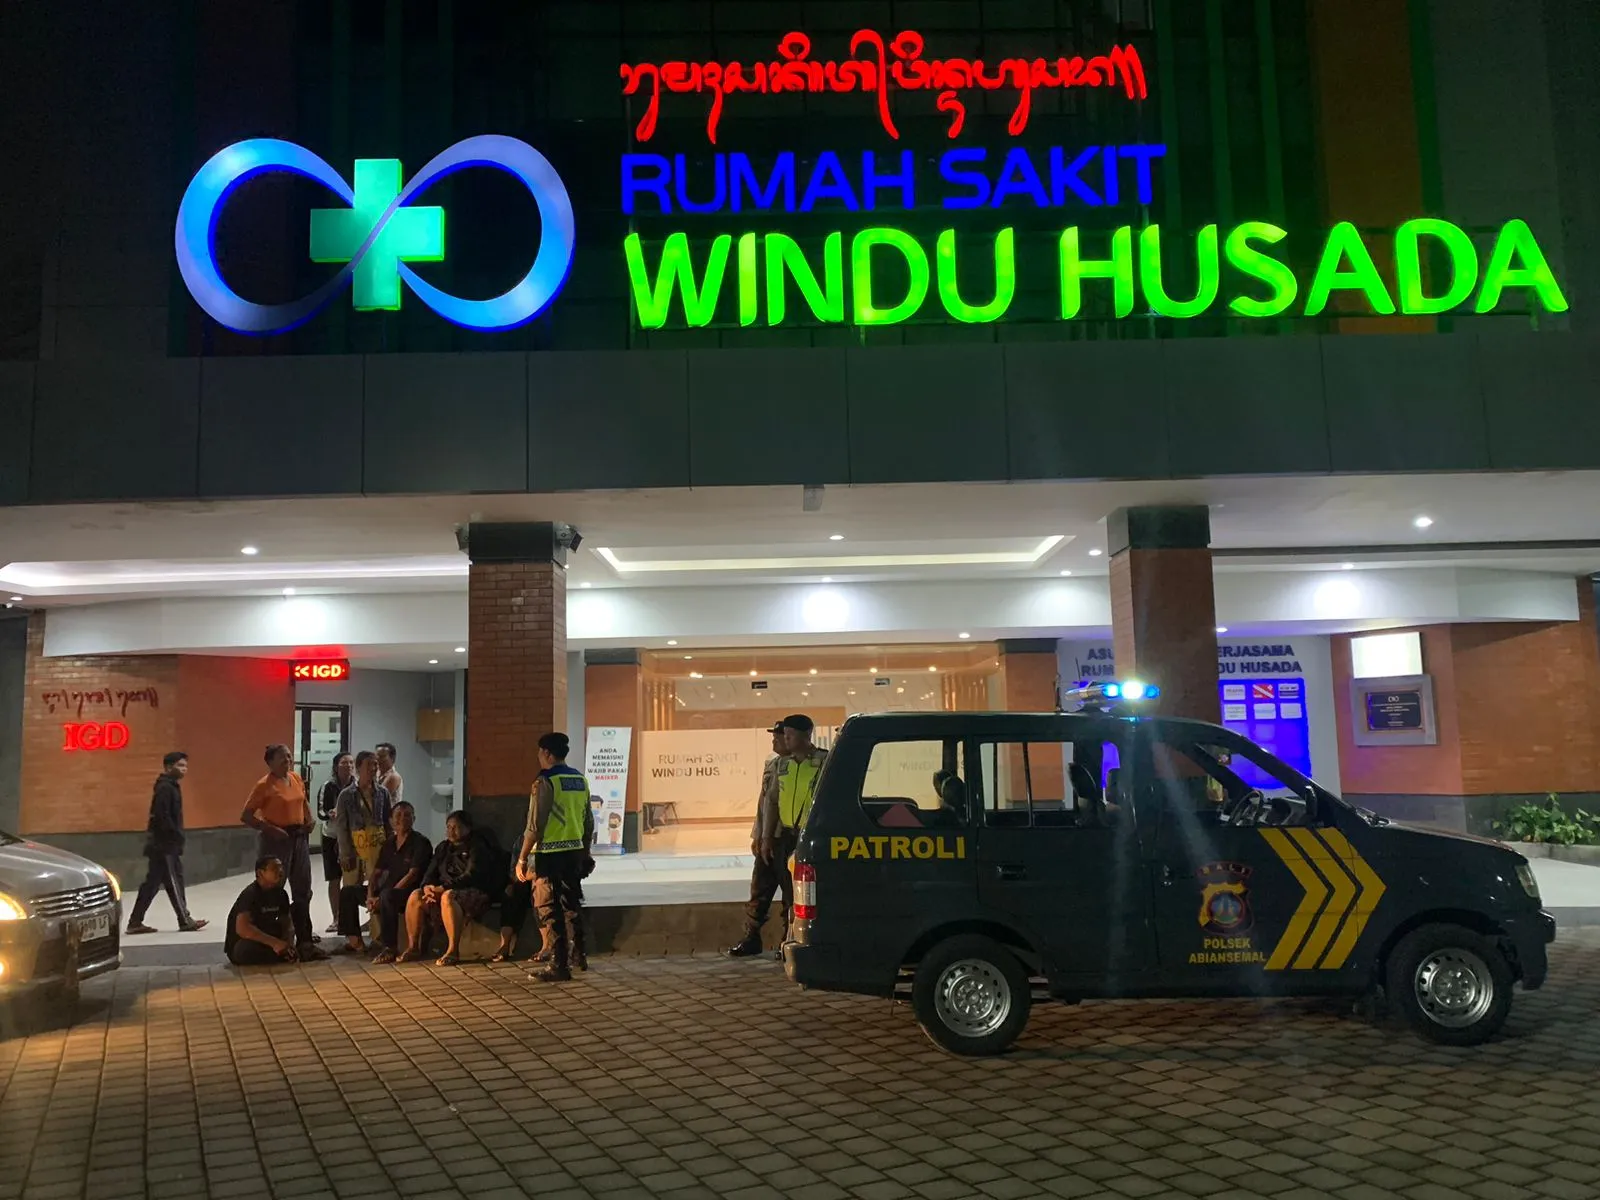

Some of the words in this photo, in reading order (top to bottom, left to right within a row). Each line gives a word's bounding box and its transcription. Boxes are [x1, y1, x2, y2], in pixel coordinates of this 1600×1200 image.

[621, 149, 915, 215] RUMAH
[939, 143, 1167, 210] SAKIT
[623, 226, 1016, 329] WINDU
[1058, 217, 1569, 320] HUSADA
[312, 664, 342, 678] IGD
[1240, 661, 1303, 673] HUSADA
[63, 721, 129, 752] IGD
[651, 767, 692, 778] WINDU
[830, 836, 966, 860] PATROLI
[1203, 937, 1251, 949] POLSEK
[1188, 951, 1266, 965] ABIANSEMAL
